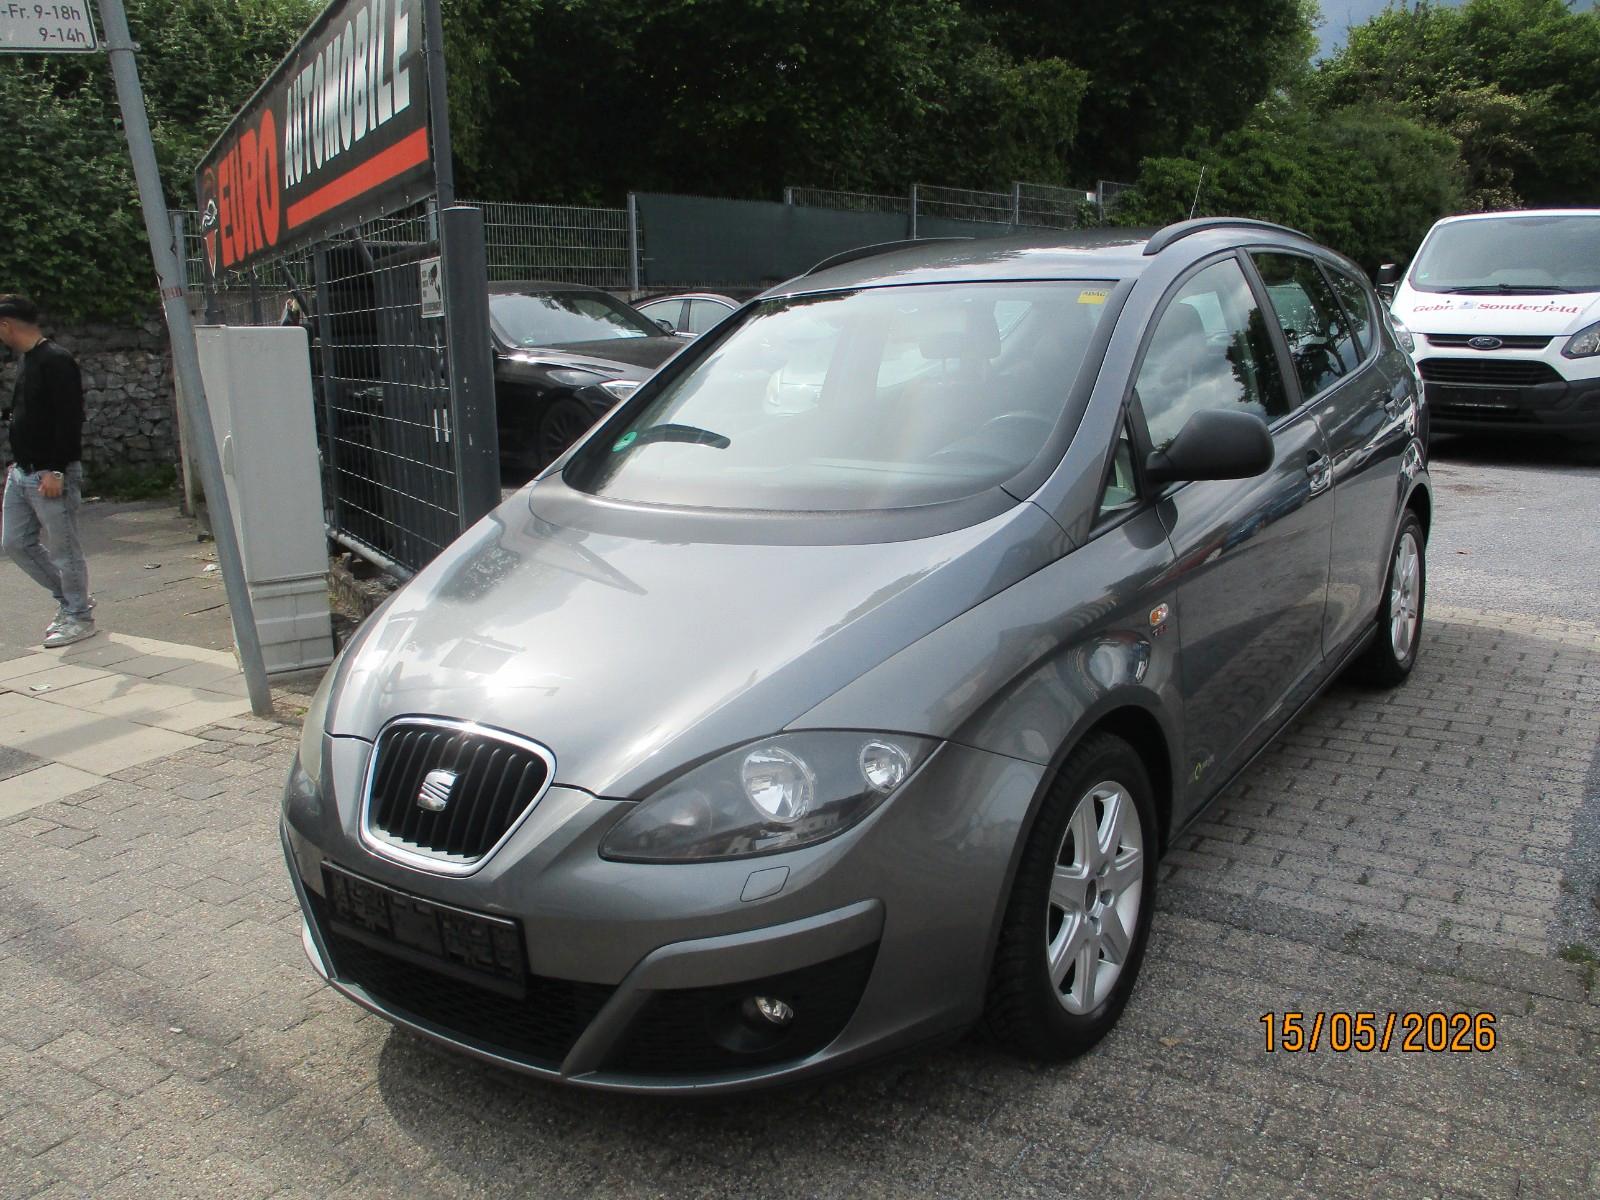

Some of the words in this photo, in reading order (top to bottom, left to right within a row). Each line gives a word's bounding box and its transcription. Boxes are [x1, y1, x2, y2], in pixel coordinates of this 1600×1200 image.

[33, 4, 81, 20] 9-18h
[38, 27, 86, 42] 9-14h
[218, 108, 280, 268] EURO
[284, 0, 410, 189] AUTOMOBILE
[1413, 304, 1454, 313] Gebr.
[1477, 303, 1579, 314] Sonderfeld
